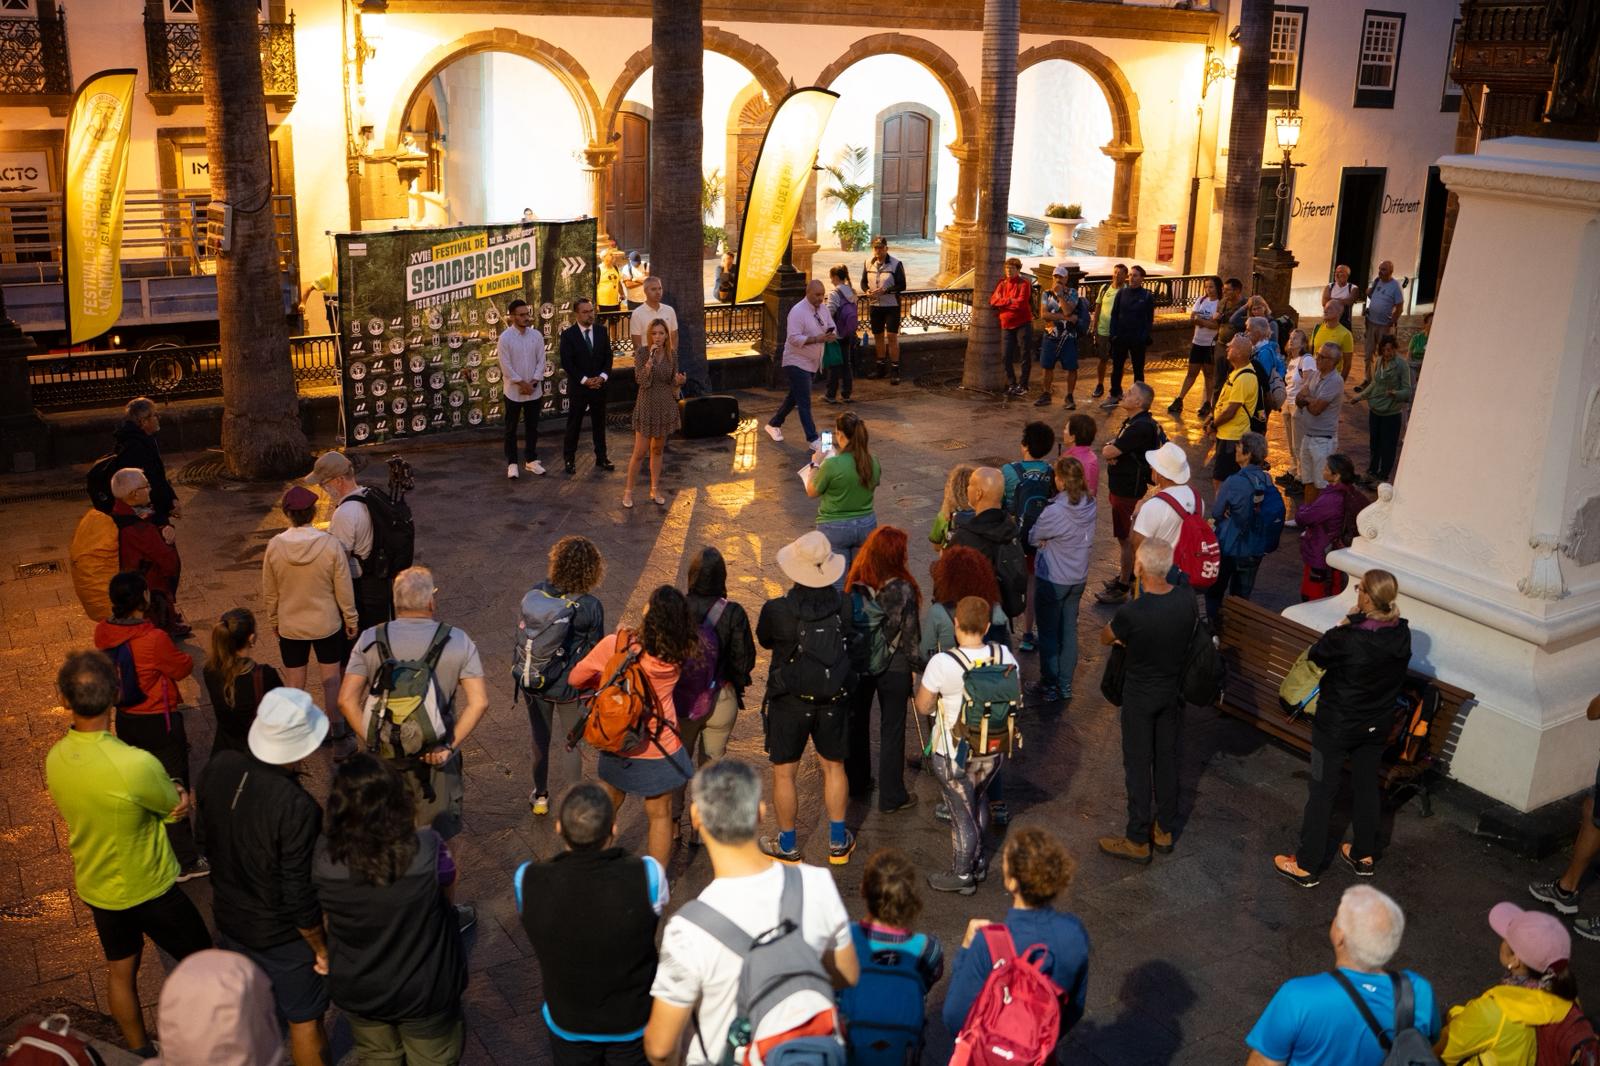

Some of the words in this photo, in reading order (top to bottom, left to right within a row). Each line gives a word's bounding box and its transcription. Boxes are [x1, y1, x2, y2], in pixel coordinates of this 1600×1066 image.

[0, 167, 38, 180] CTO
[100, 203, 111, 218] DE
[1291, 197, 1335, 218] Different
[1382, 194, 1421, 215] Different
[101, 222, 110, 247] ISLA
[436, 240, 471, 259] FESTIVAL
[475, 237, 485, 249] DE
[411, 242, 531, 295] SENDERISMO
[83, 257, 98, 315] FESTIVAL
[479, 284, 484, 294] Y
[487, 274, 520, 291] MONTAÑA
[415, 298, 430, 310] ISLA
[432, 296, 441, 306] DE
[441, 293, 450, 303] LA
[451, 287, 472, 301] PALMA
